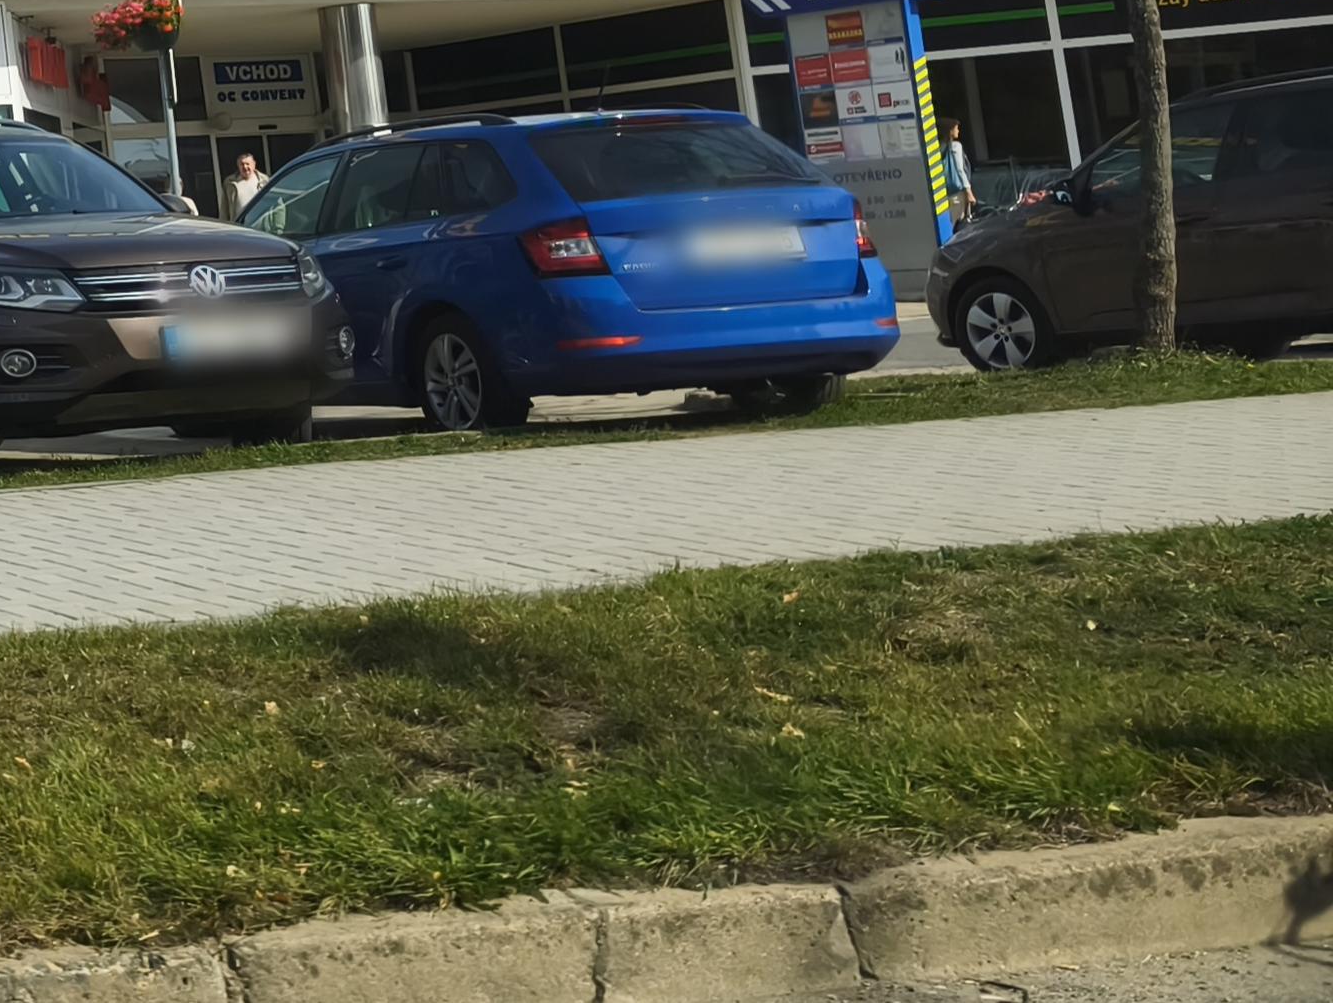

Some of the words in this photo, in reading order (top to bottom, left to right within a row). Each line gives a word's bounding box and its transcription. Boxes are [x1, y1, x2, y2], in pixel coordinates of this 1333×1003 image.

[225, 64, 291, 81] VCHOD
[217, 91, 236, 103] OC
[241, 88, 306, 102] CONVENT
